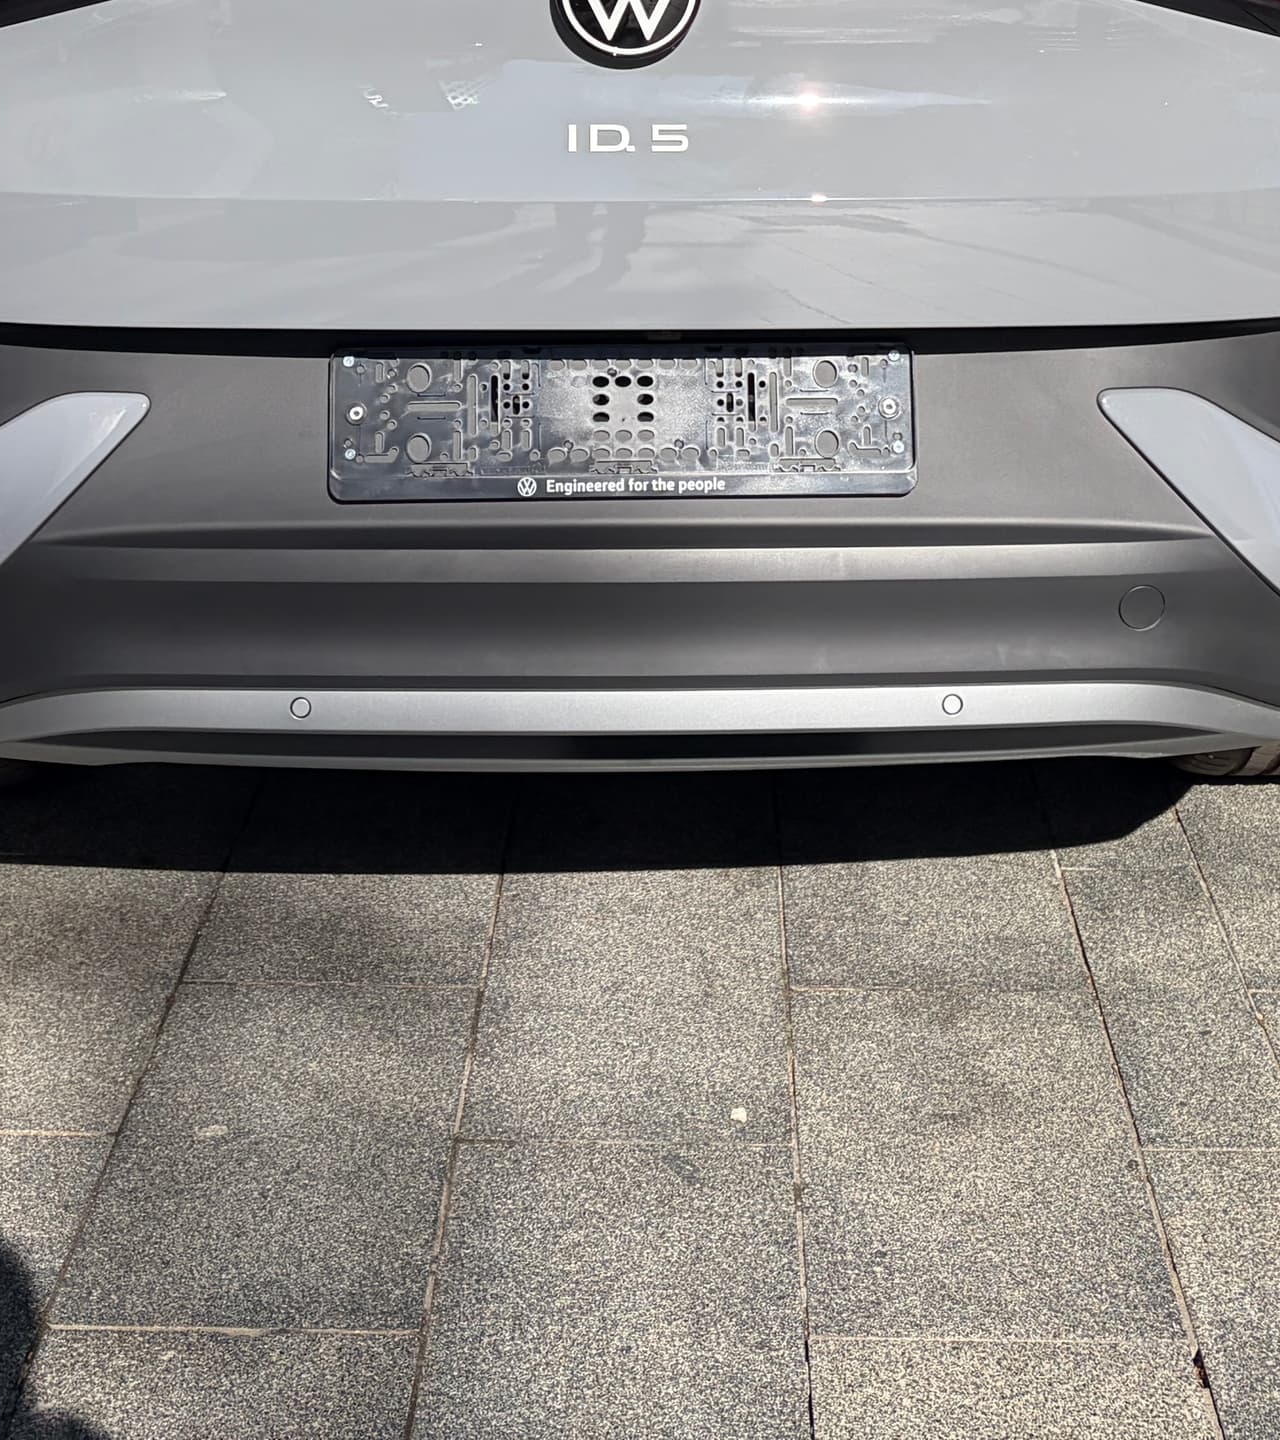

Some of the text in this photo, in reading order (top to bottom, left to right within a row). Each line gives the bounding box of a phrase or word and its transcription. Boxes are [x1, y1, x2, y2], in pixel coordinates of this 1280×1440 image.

[546, 478, 625, 495] Engineered
[628, 478, 649, 492] for
[651, 477, 675, 492] the
[678, 477, 726, 494] people
